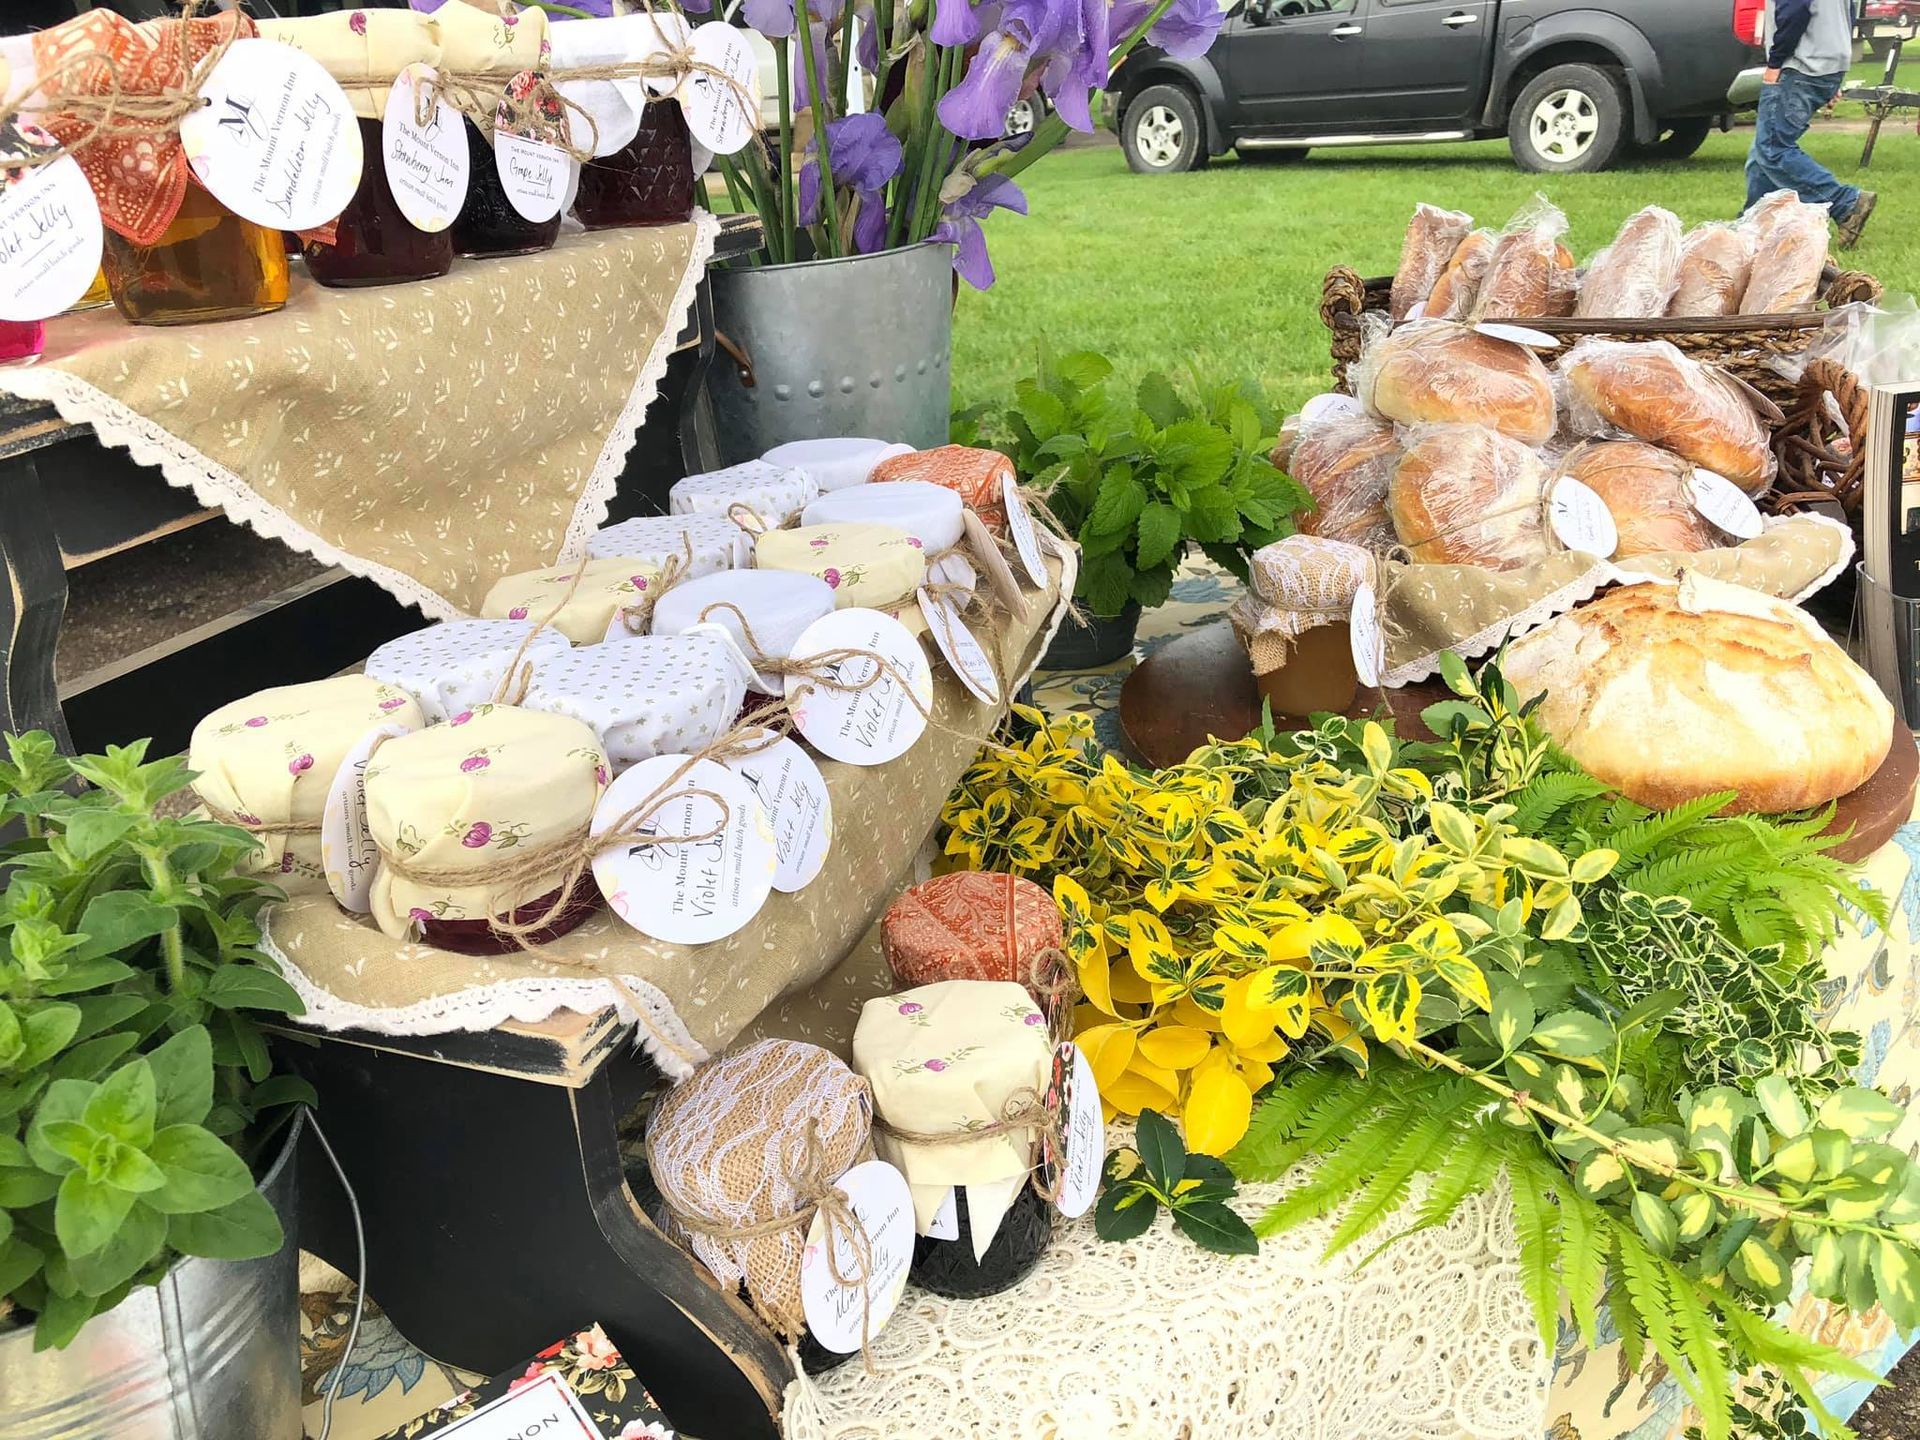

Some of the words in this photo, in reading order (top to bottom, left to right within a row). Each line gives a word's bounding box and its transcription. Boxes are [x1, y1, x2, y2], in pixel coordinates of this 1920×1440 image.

[252, 171, 266, 194] The
[259, 135, 278, 172] Mount
[270, 92, 292, 133] Vernon
[283, 71, 298, 92] Inn
[399, 121, 411, 137] The
[411, 131, 430, 151] Mount
[430, 143, 449, 164] Vernon
[449, 159, 460, 172] Inn
[265, 141, 306, 219] Dandelion
[294, 91, 331, 132] Jelly
[28, 203, 75, 241] Jelly
[839, 718, 852, 738] The
[846, 689, 862, 718] Moun
[857, 657, 873, 684] Verno
[868, 631, 880, 649] Inn
[855, 692, 887, 749] Violet
[782, 756, 792, 773] Inn
[684, 778, 696, 799] In
[773, 773, 787, 804] Vernon
[683, 802, 693, 837] ernon
[738, 804, 747, 828] goods
[769, 808, 779, 830] ount
[737, 829, 745, 853] batch
[676, 850, 689, 888] Mount
[734, 853, 743, 876] small
[673, 889, 685, 915] The
[690, 868, 719, 918] Violet
[732, 876, 742, 908] artisan
[824, 1283, 839, 1303] The
[886, 1206, 900, 1223] Inn
[870, 1246, 889, 1276] elly
